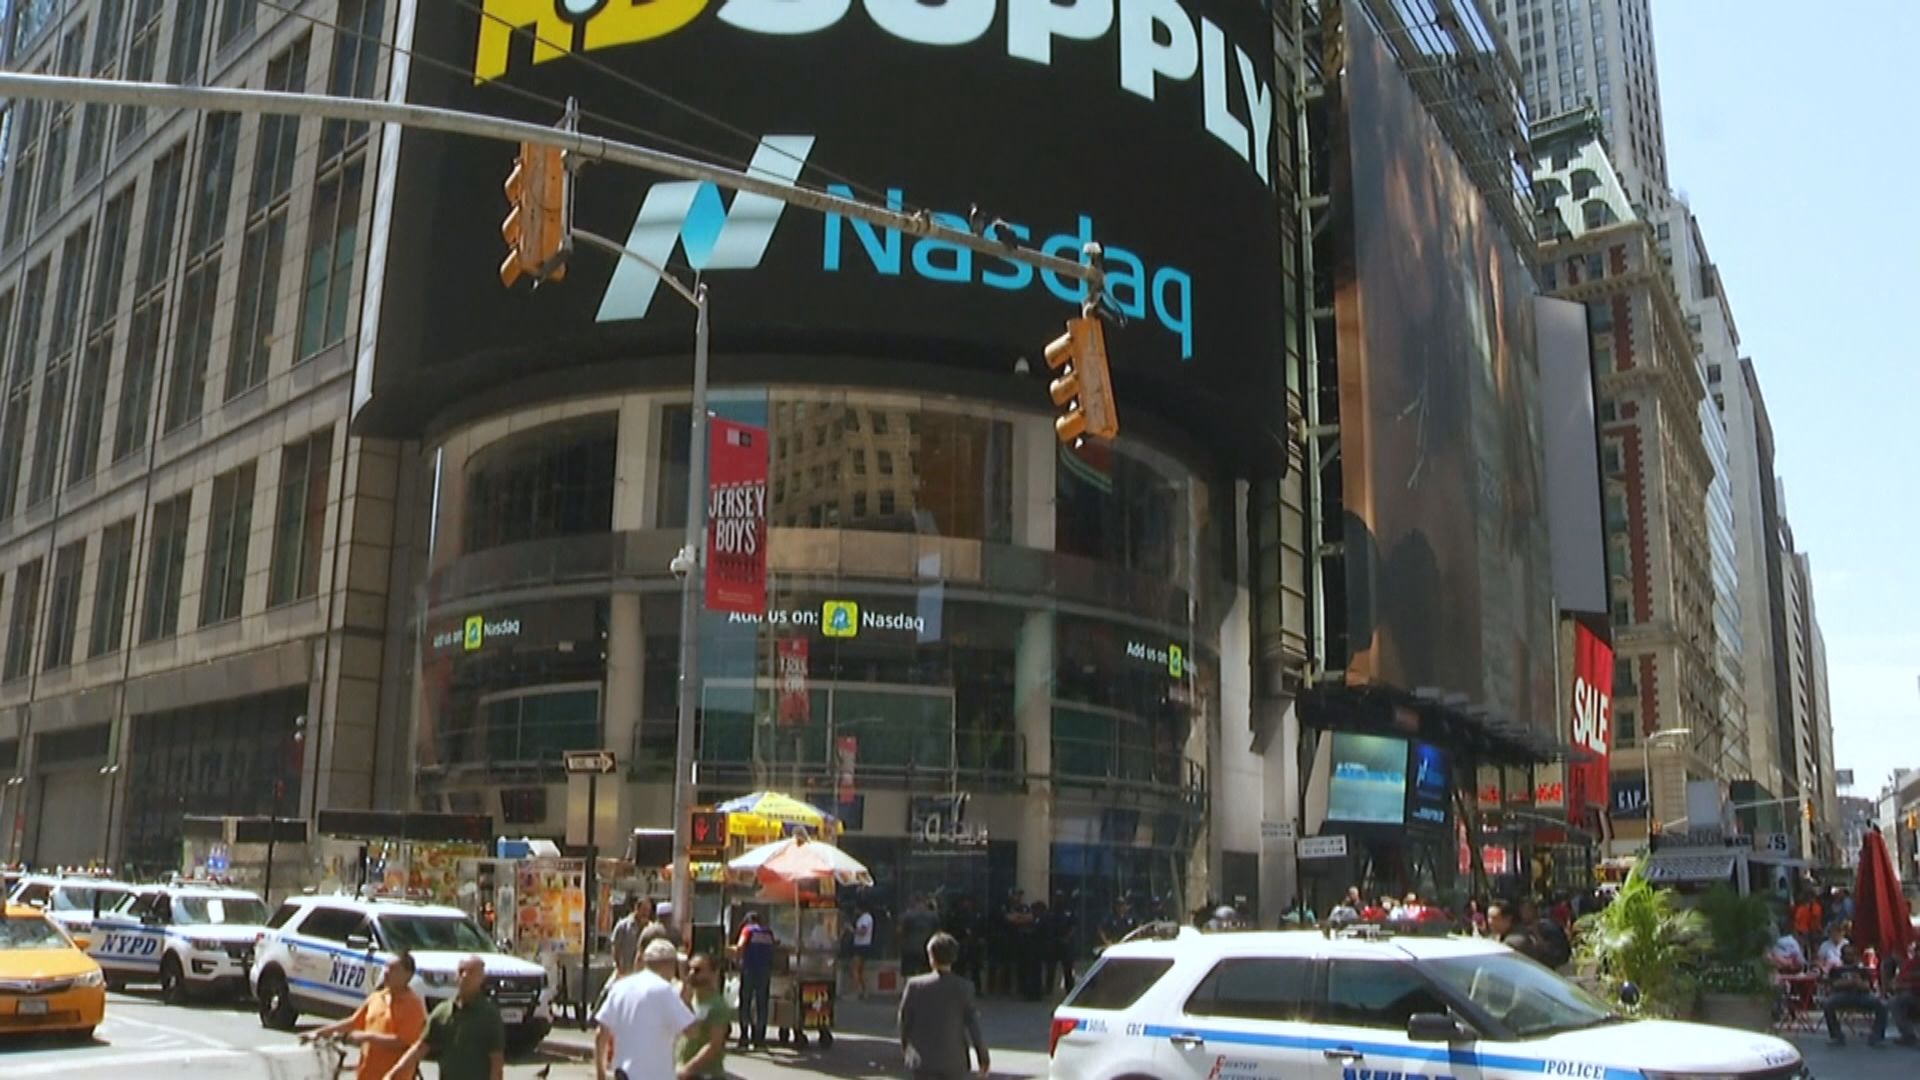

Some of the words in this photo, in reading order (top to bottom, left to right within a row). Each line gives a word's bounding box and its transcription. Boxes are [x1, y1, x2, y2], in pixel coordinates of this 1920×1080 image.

[823, 183, 1192, 360] Nasdaq
[708, 484, 767, 520] JERSEY
[714, 517, 757, 556] BOYS
[484, 618, 520, 637] Nasdaq
[768, 610, 787, 624] us
[792, 611, 819, 625] on:
[862, 610, 925, 633] Nasdaq
[1127, 641, 1145, 659] Add
[1573, 675, 1608, 757] SALE
[1617, 789, 1642, 809] GAP
[101, 934, 157, 956] NYPD
[329, 961, 366, 988] NYPD
[1546, 1060, 1603, 1080] POLICE
